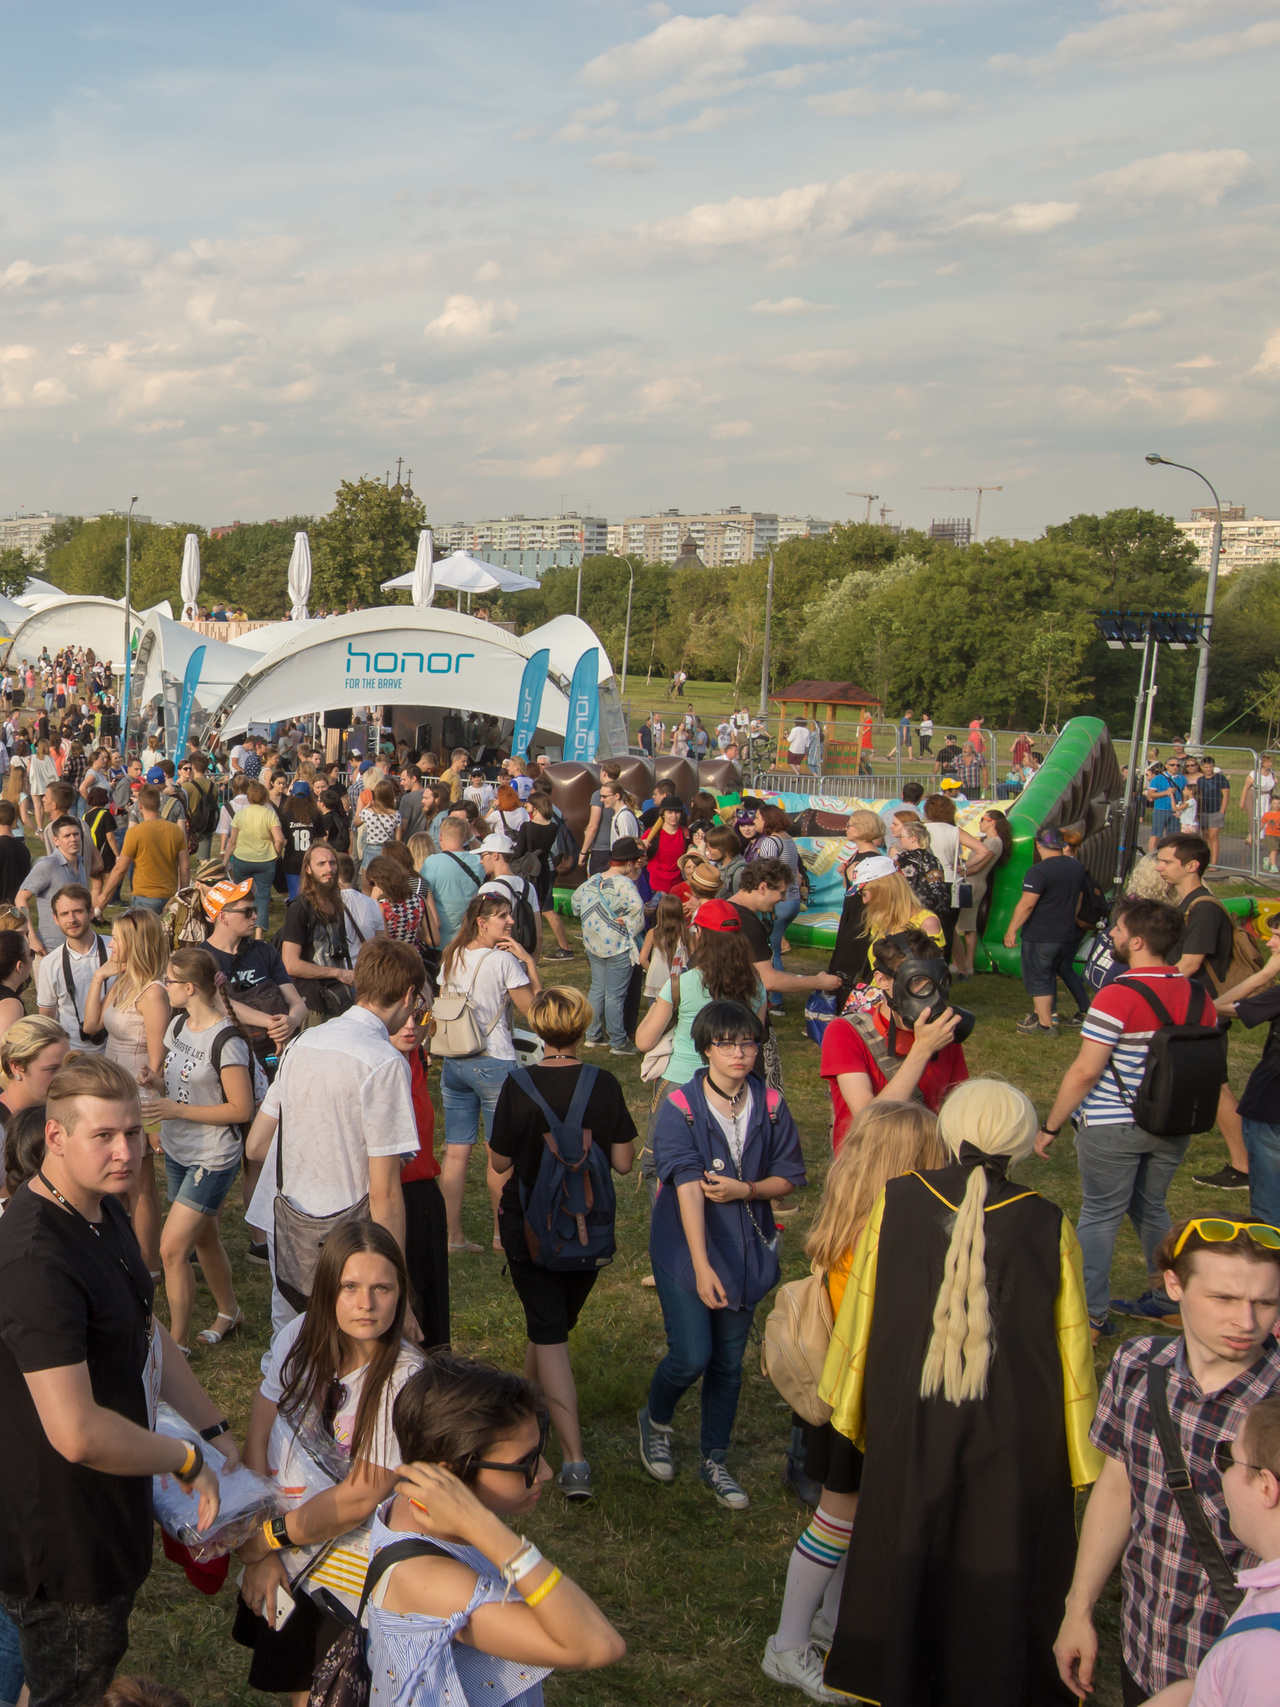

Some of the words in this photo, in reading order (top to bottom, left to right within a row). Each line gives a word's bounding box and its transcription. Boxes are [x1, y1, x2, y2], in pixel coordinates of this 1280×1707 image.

[345, 641, 476, 674] honor
[344, 678, 360, 690] FOR
[362, 678, 376, 690] THE
[377, 678, 403, 690] BRAVE
[292, 829, 311, 852] 18
[191, 1047, 206, 1061] LIKE
